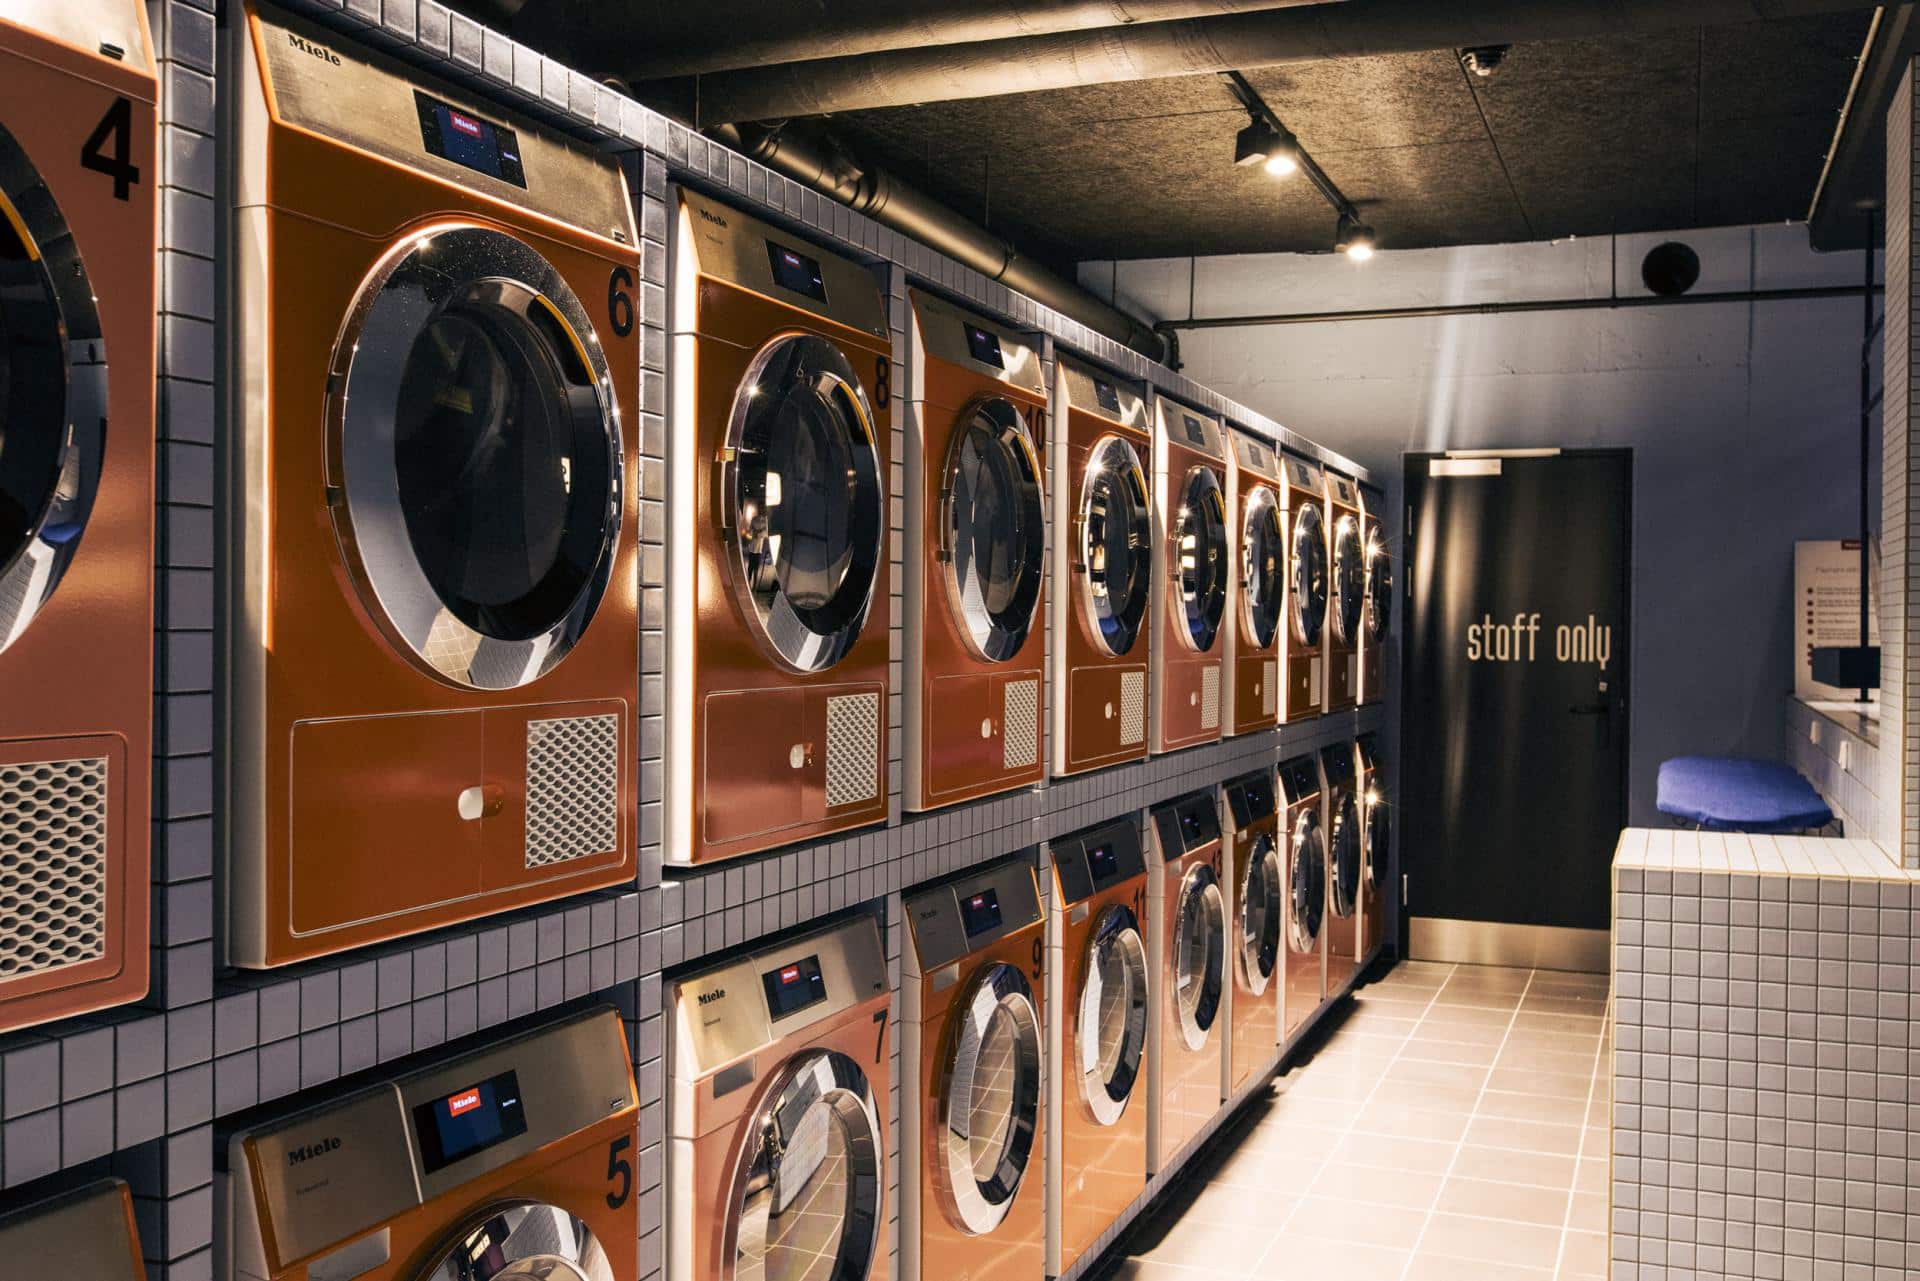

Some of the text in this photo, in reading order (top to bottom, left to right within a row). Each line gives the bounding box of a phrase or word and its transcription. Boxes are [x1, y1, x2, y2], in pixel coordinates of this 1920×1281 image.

[287, 33, 341, 66] Miele
[80, 96, 140, 201] 4
[699, 208, 728, 228] Miele
[608, 266, 633, 337] 6
[876, 355, 889, 410] 8
[1025, 403, 1047, 450] 10
[1467, 613, 1611, 670] staff only
[1133, 884, 1146, 921] 11
[1032, 937, 1042, 979] 9
[698, 989, 726, 1006] Miele
[873, 1007, 888, 1065] 7
[453, 1095, 477, 1110] Miele
[288, 1137, 342, 1166] Miele
[606, 1134, 631, 1210] 5
